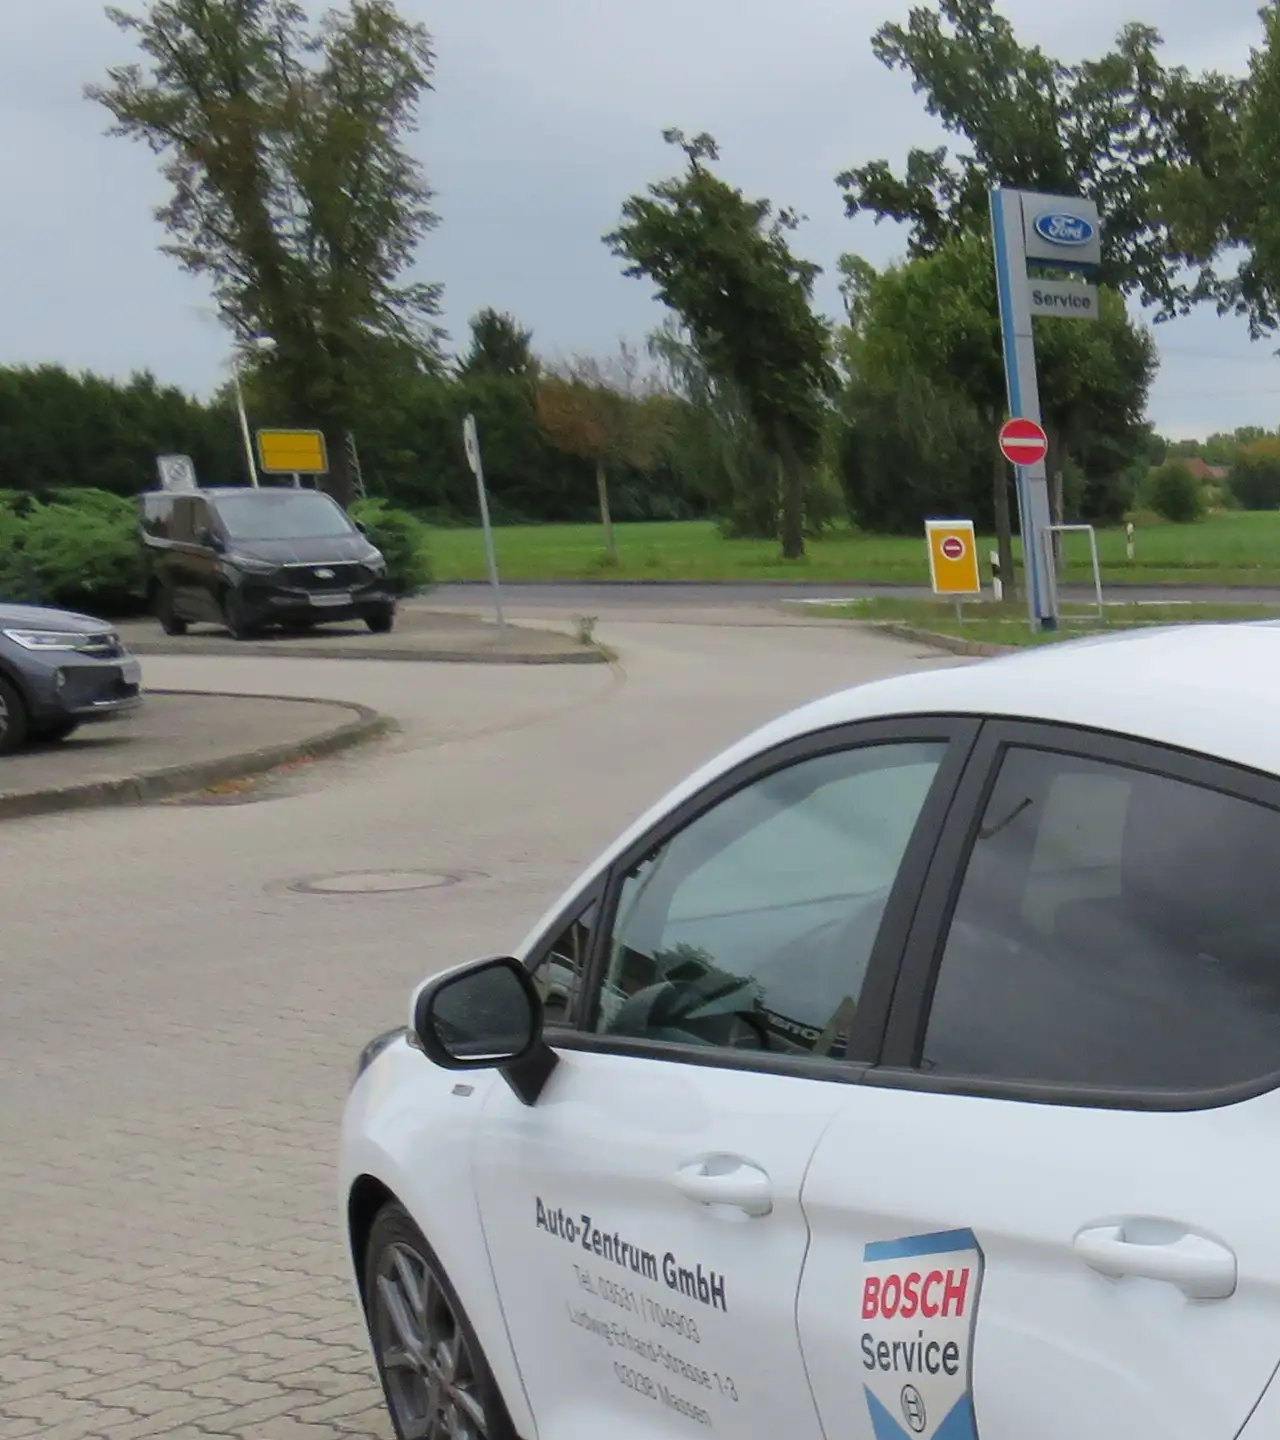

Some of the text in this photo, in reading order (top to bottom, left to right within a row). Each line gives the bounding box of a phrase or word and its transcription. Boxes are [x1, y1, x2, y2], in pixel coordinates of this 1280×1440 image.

[1032, 289, 1092, 310] Service
[535, 1196, 728, 1313] Auto-Zentrum GmbH
[861, 1268, 970, 1320] BOSCH
[860, 1329, 960, 1376] Service
